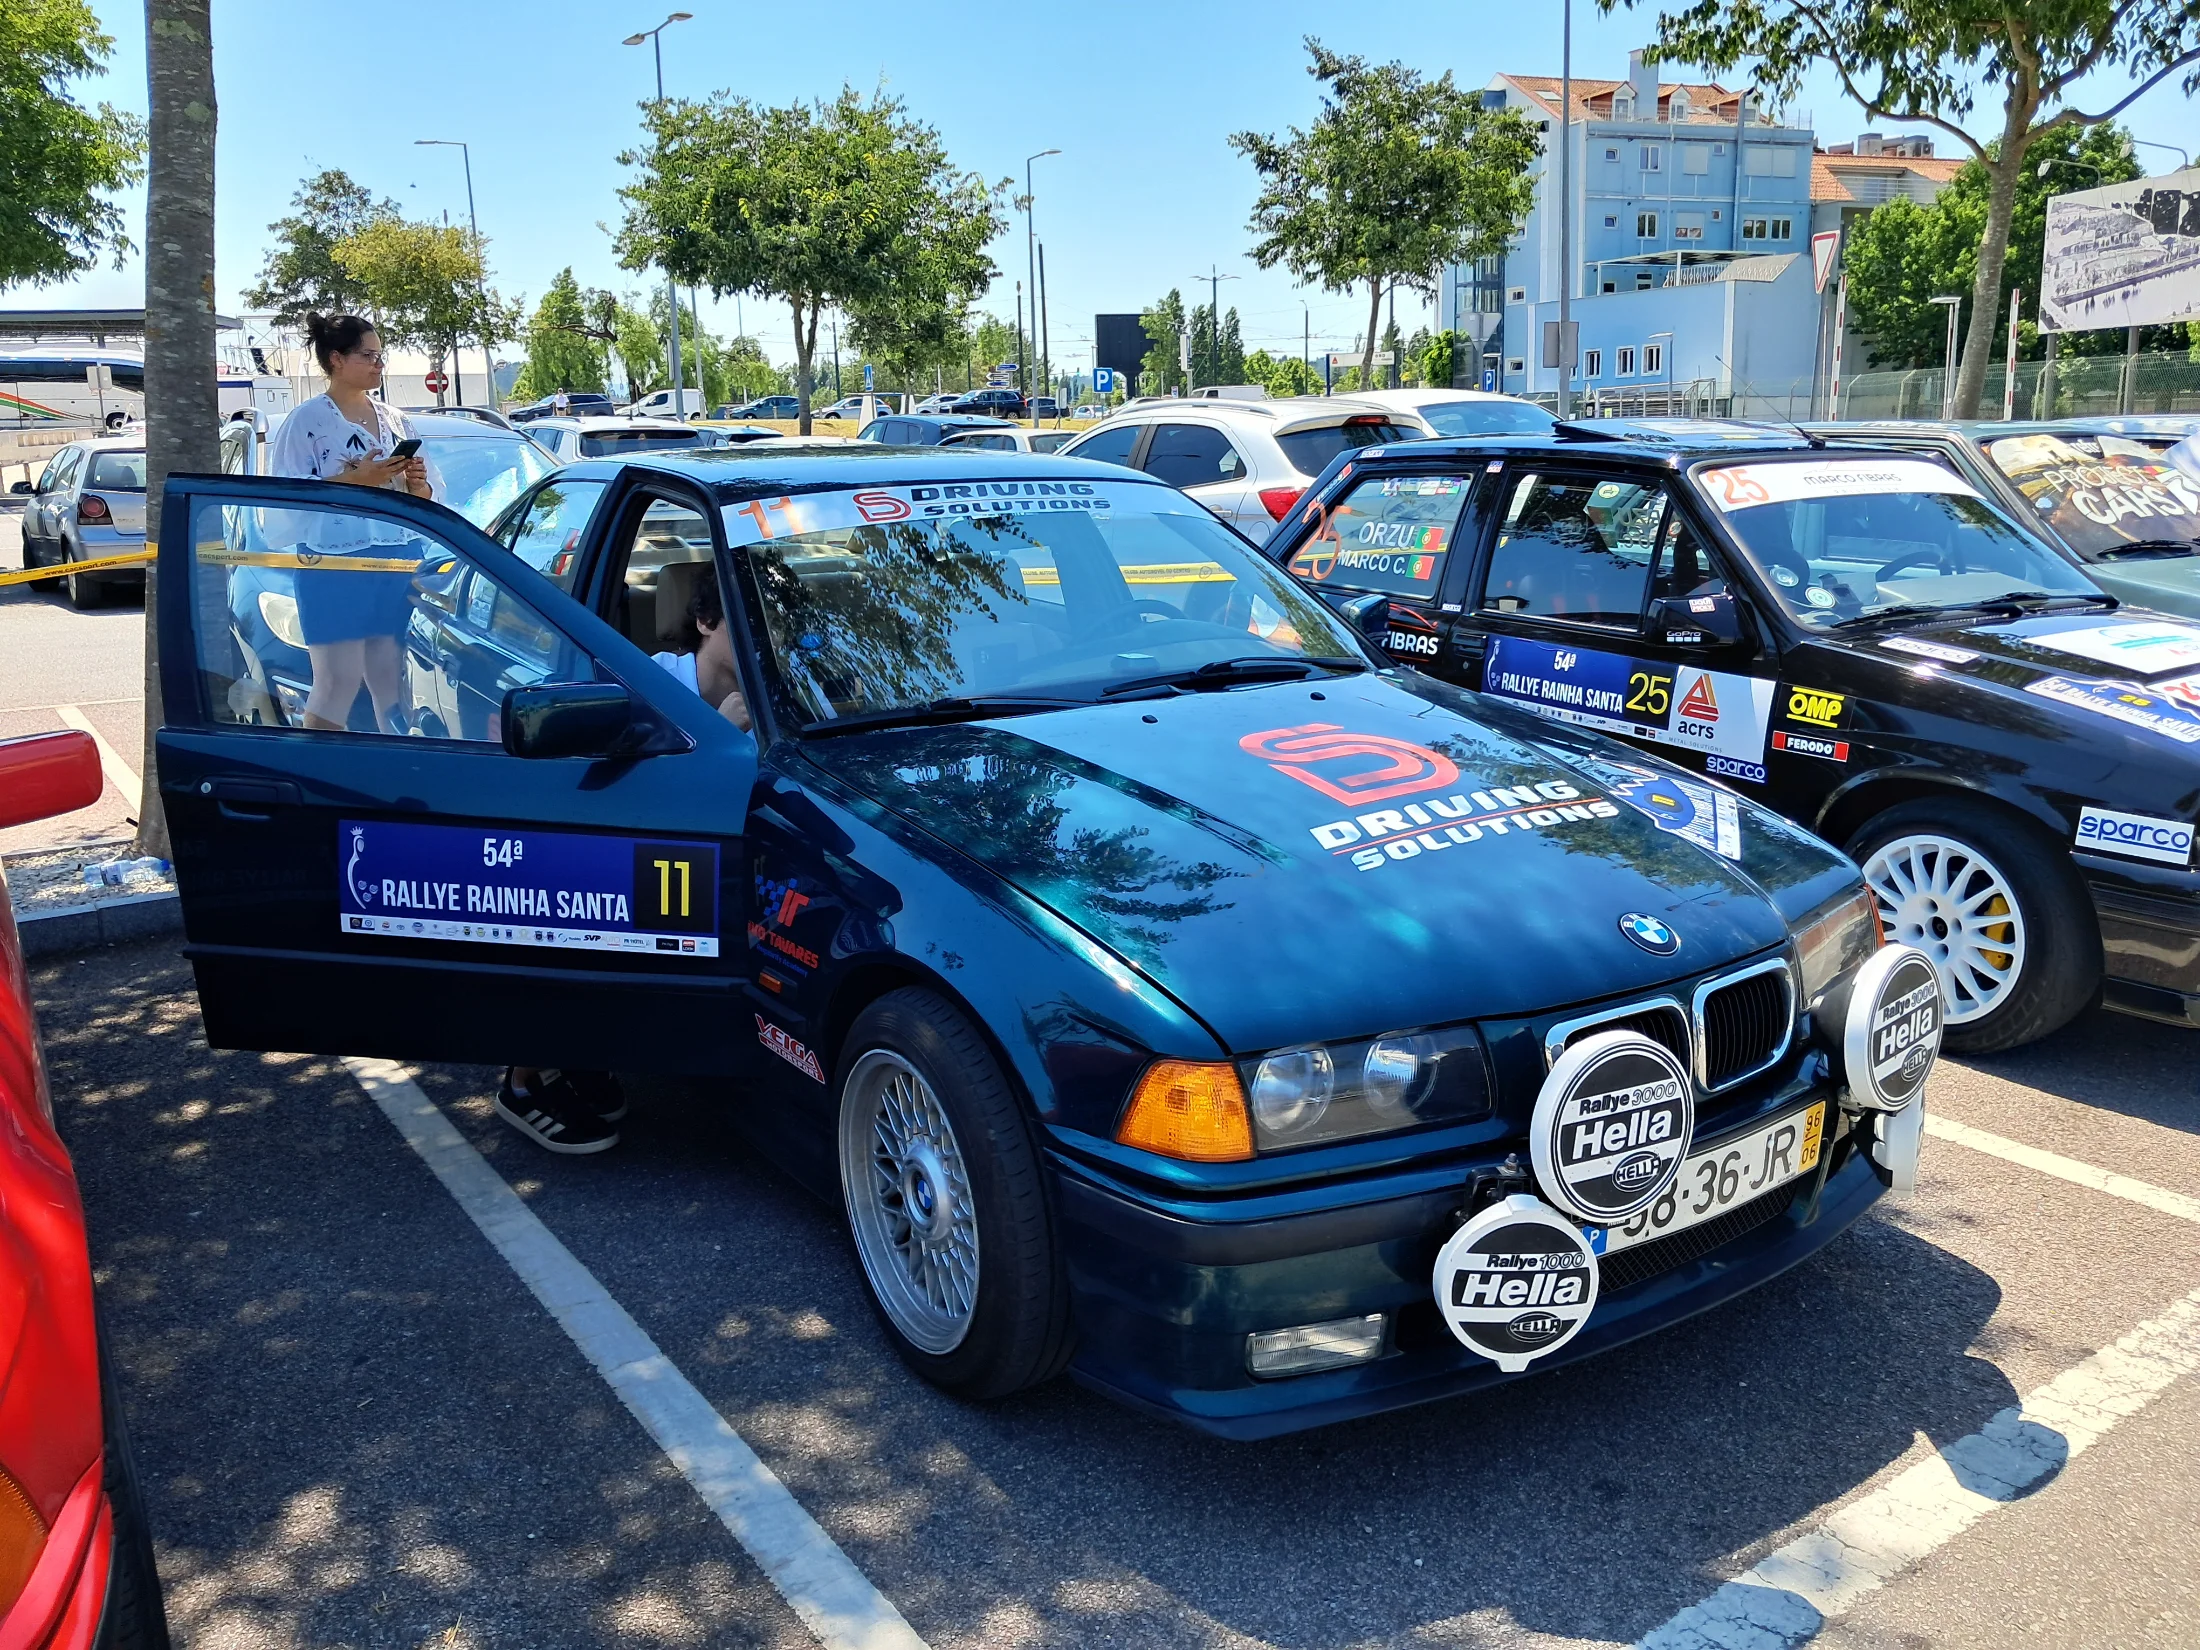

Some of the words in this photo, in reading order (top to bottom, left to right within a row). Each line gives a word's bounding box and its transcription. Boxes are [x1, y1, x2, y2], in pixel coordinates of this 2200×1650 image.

[1097, 371, 1109, 390] P
[1486, 372, 1492, 391] P
[910, 483, 1095, 502] DRIVING
[1706, 468, 1770, 505] 25
[1803, 474, 1856, 486] MARCO
[1857, 473, 1902, 482] FIBRAS
[2042, 466, 2150, 493] PROJECT
[738, 496, 805, 539] 11
[924, 499, 1112, 516] SOLUTIONS
[2072, 485, 2185, 525] CARS
[1288, 503, 1352, 580] 25
[1358, 521, 1416, 548] ORZU
[44, 560, 117, 576] www.cacsport.com
[1337, 549, 1390, 573] MARCO
[1501, 672, 1541, 697] RALLYE
[1541, 680, 1583, 705] RAINHA
[1585, 688, 1623, 714] SANTA
[1625, 672, 1672, 715] 25
[1789, 693, 1842, 721] OMP
[1678, 720, 1715, 740] acrs
[1668, 736, 1687, 746] METAL
[1689, 741, 1723, 753] SOLUTIONS
[1786, 736, 1834, 755] FERODO
[1706, 756, 1766, 780] sparco
[1309, 780, 1580, 850] DRIVING
[1350, 801, 1620, 872] SOLUTIONS
[2078, 815, 2190, 850] sparco
[483, 837, 523, 868] 54ª
[382, 878, 461, 912] RALLYE
[467, 884, 551, 917] RAINHA
[556, 890, 630, 922] SANTA
[653, 859, 690, 917] 11
[769, 931, 819, 969] TAVARES
[1883, 997, 1911, 1023] Rallye
[1911, 981, 1935, 1008] 3000
[1879, 1006, 1934, 1061] Hella
[755, 1013, 826, 1083] VEIGA
[765, 1040, 819, 1079] MOTORSPORT
[1903, 1051, 1929, 1074] HELLA
[1579, 1093, 1630, 1116] Rallye
[1631, 1081, 1677, 1107] 3000
[1572, 1109, 1673, 1160] Hella
[1805, 1109, 1822, 1133] 96
[1801, 1143, 1818, 1165] 06
[1616, 1158, 1661, 1182] HELLA
[1590, 1229, 1600, 1246] P
[1486, 1254, 1538, 1271] Rallye
[1539, 1252, 1586, 1270] 1000
[1461, 1273, 1583, 1306] Hella
[1510, 1319, 1562, 1334] HELLA
